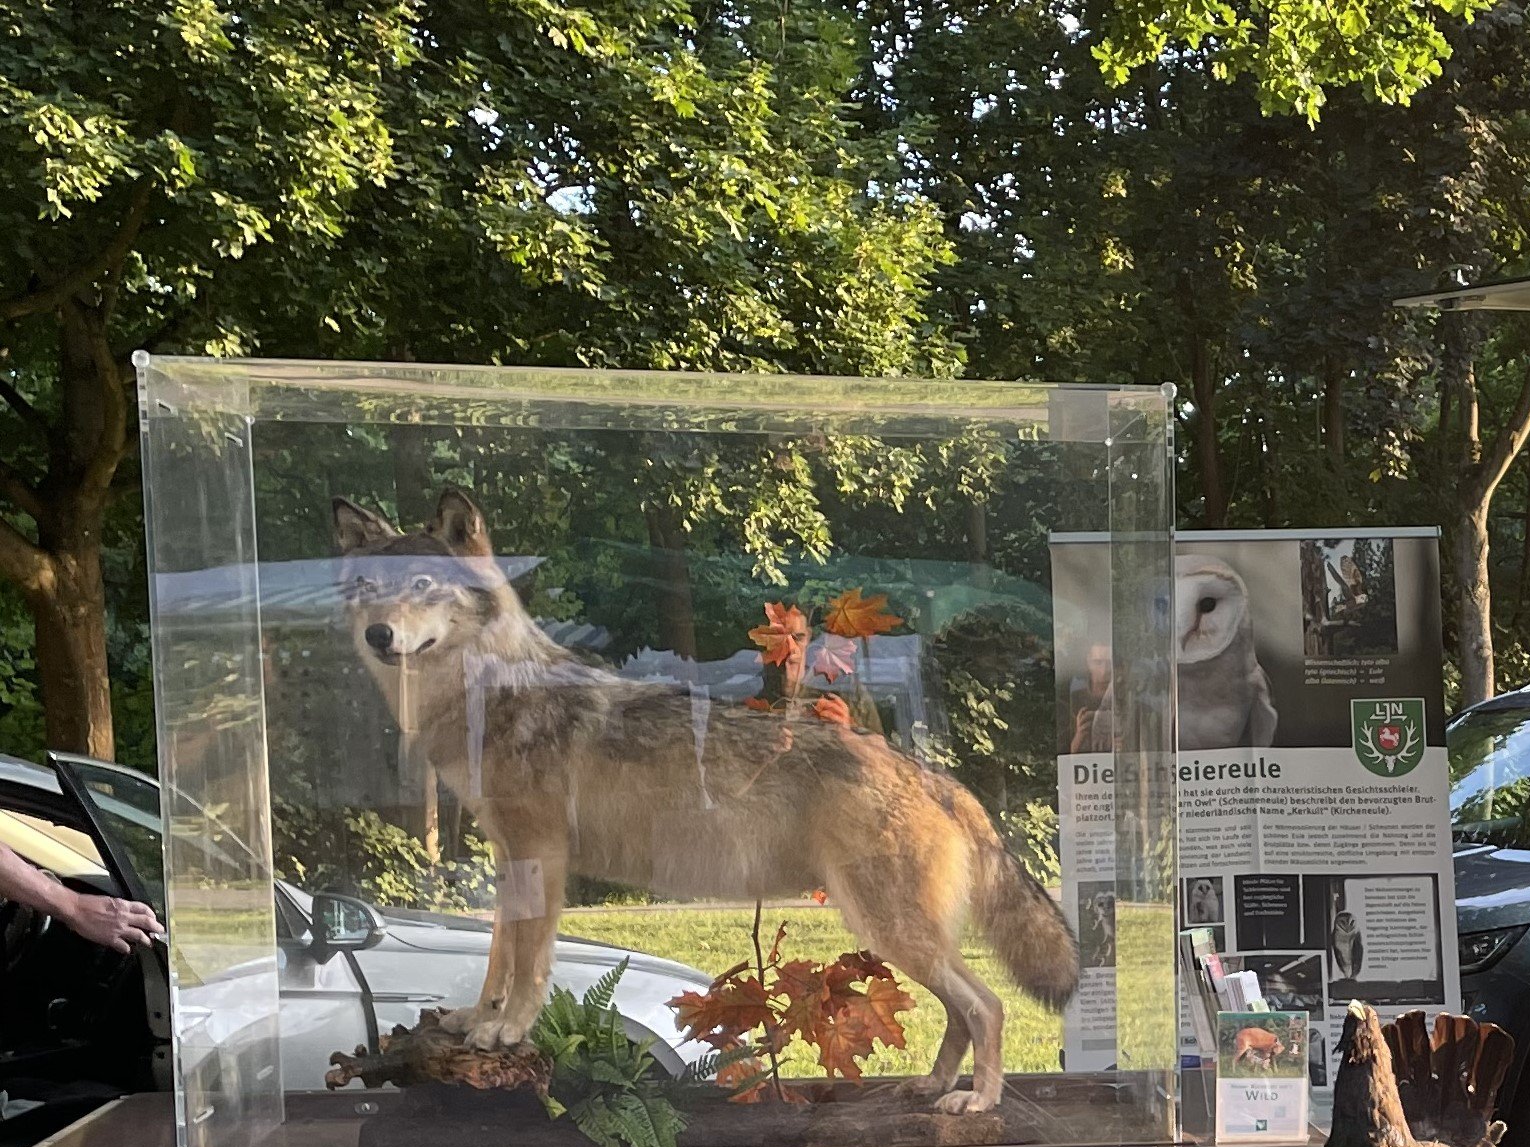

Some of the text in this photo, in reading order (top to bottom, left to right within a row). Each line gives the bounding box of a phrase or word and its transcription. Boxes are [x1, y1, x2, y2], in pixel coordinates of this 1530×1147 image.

[1074, 763, 1114, 784] Die
[1201, 788, 1213, 796] sie
[1216, 787, 1240, 795] durch
[1243, 786, 1259, 794] den
[1262, 786, 1343, 794] charakteristischen
[1290, 796, 1337, 804] beschreibt
[1358, 796, 1412, 805] bevorzugten
[1415, 795, 1436, 803] Brut-
[1186, 807, 1257, 817] niederländische
[1260, 807, 1284, 815] Name
